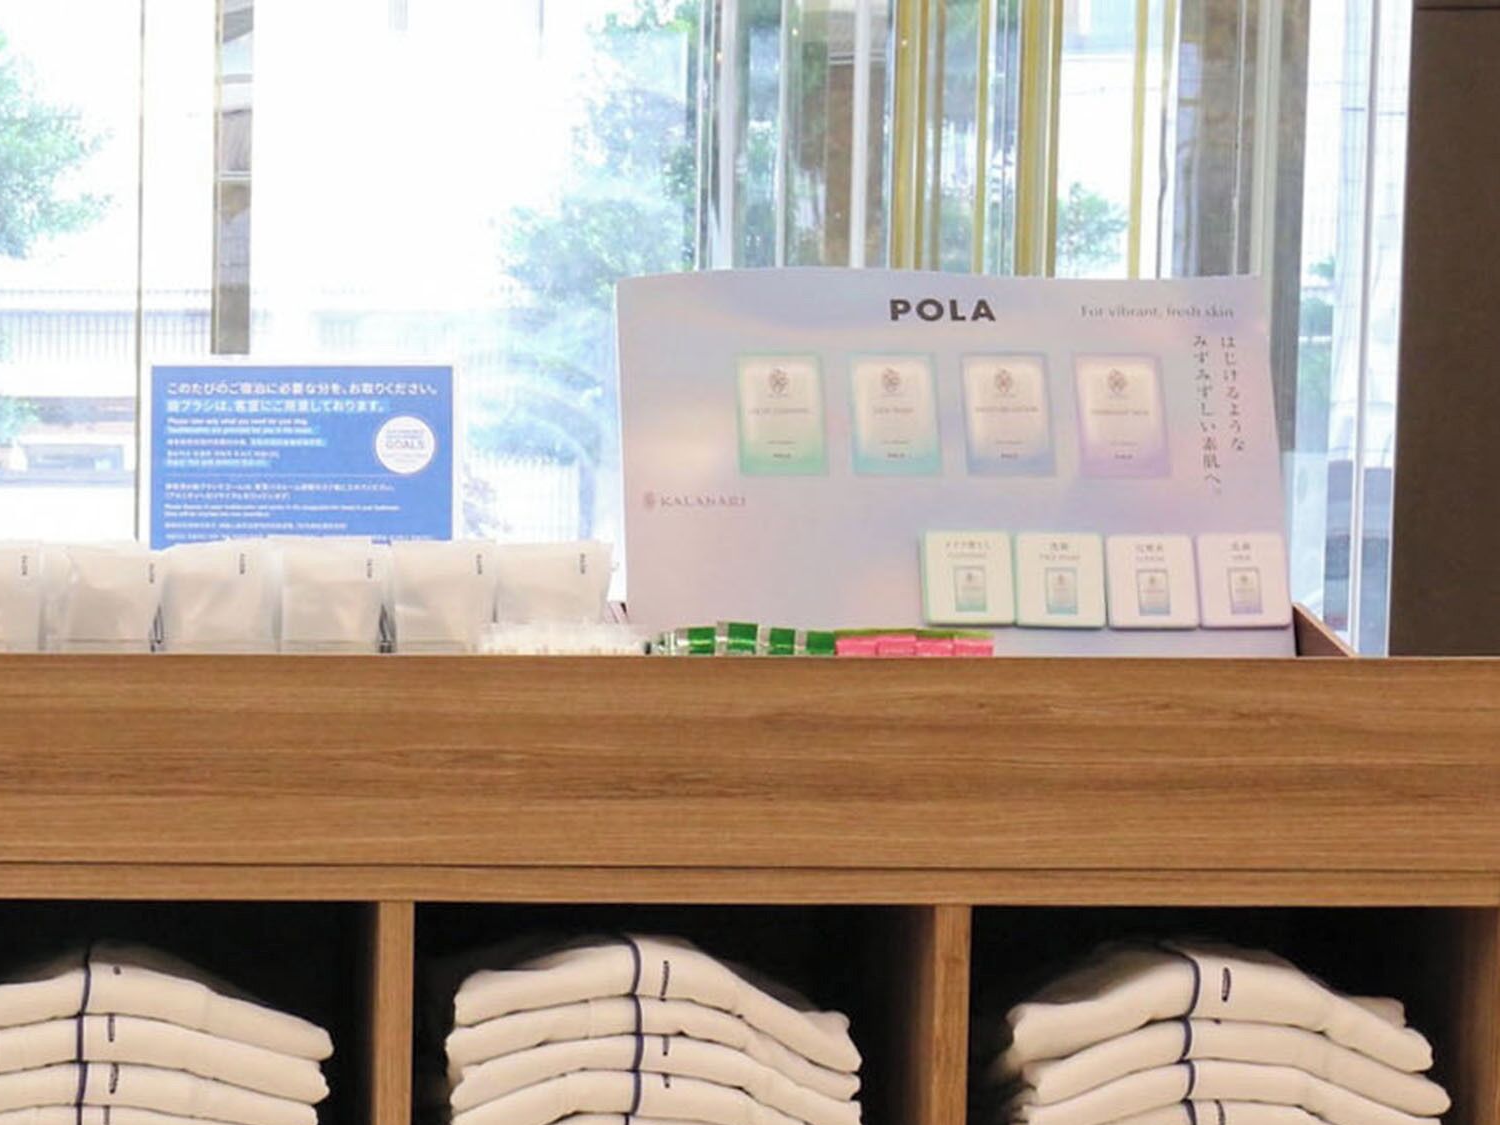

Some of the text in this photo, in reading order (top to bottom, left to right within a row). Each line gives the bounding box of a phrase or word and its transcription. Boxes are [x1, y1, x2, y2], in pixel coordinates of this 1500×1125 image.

[890, 299, 996, 322] POLA
[1081, 305, 1103, 318] For
[1167, 304, 1201, 319] fresh
[1205, 304, 1234, 319] skin
[1221, 336, 1246, 452] はじけるような
